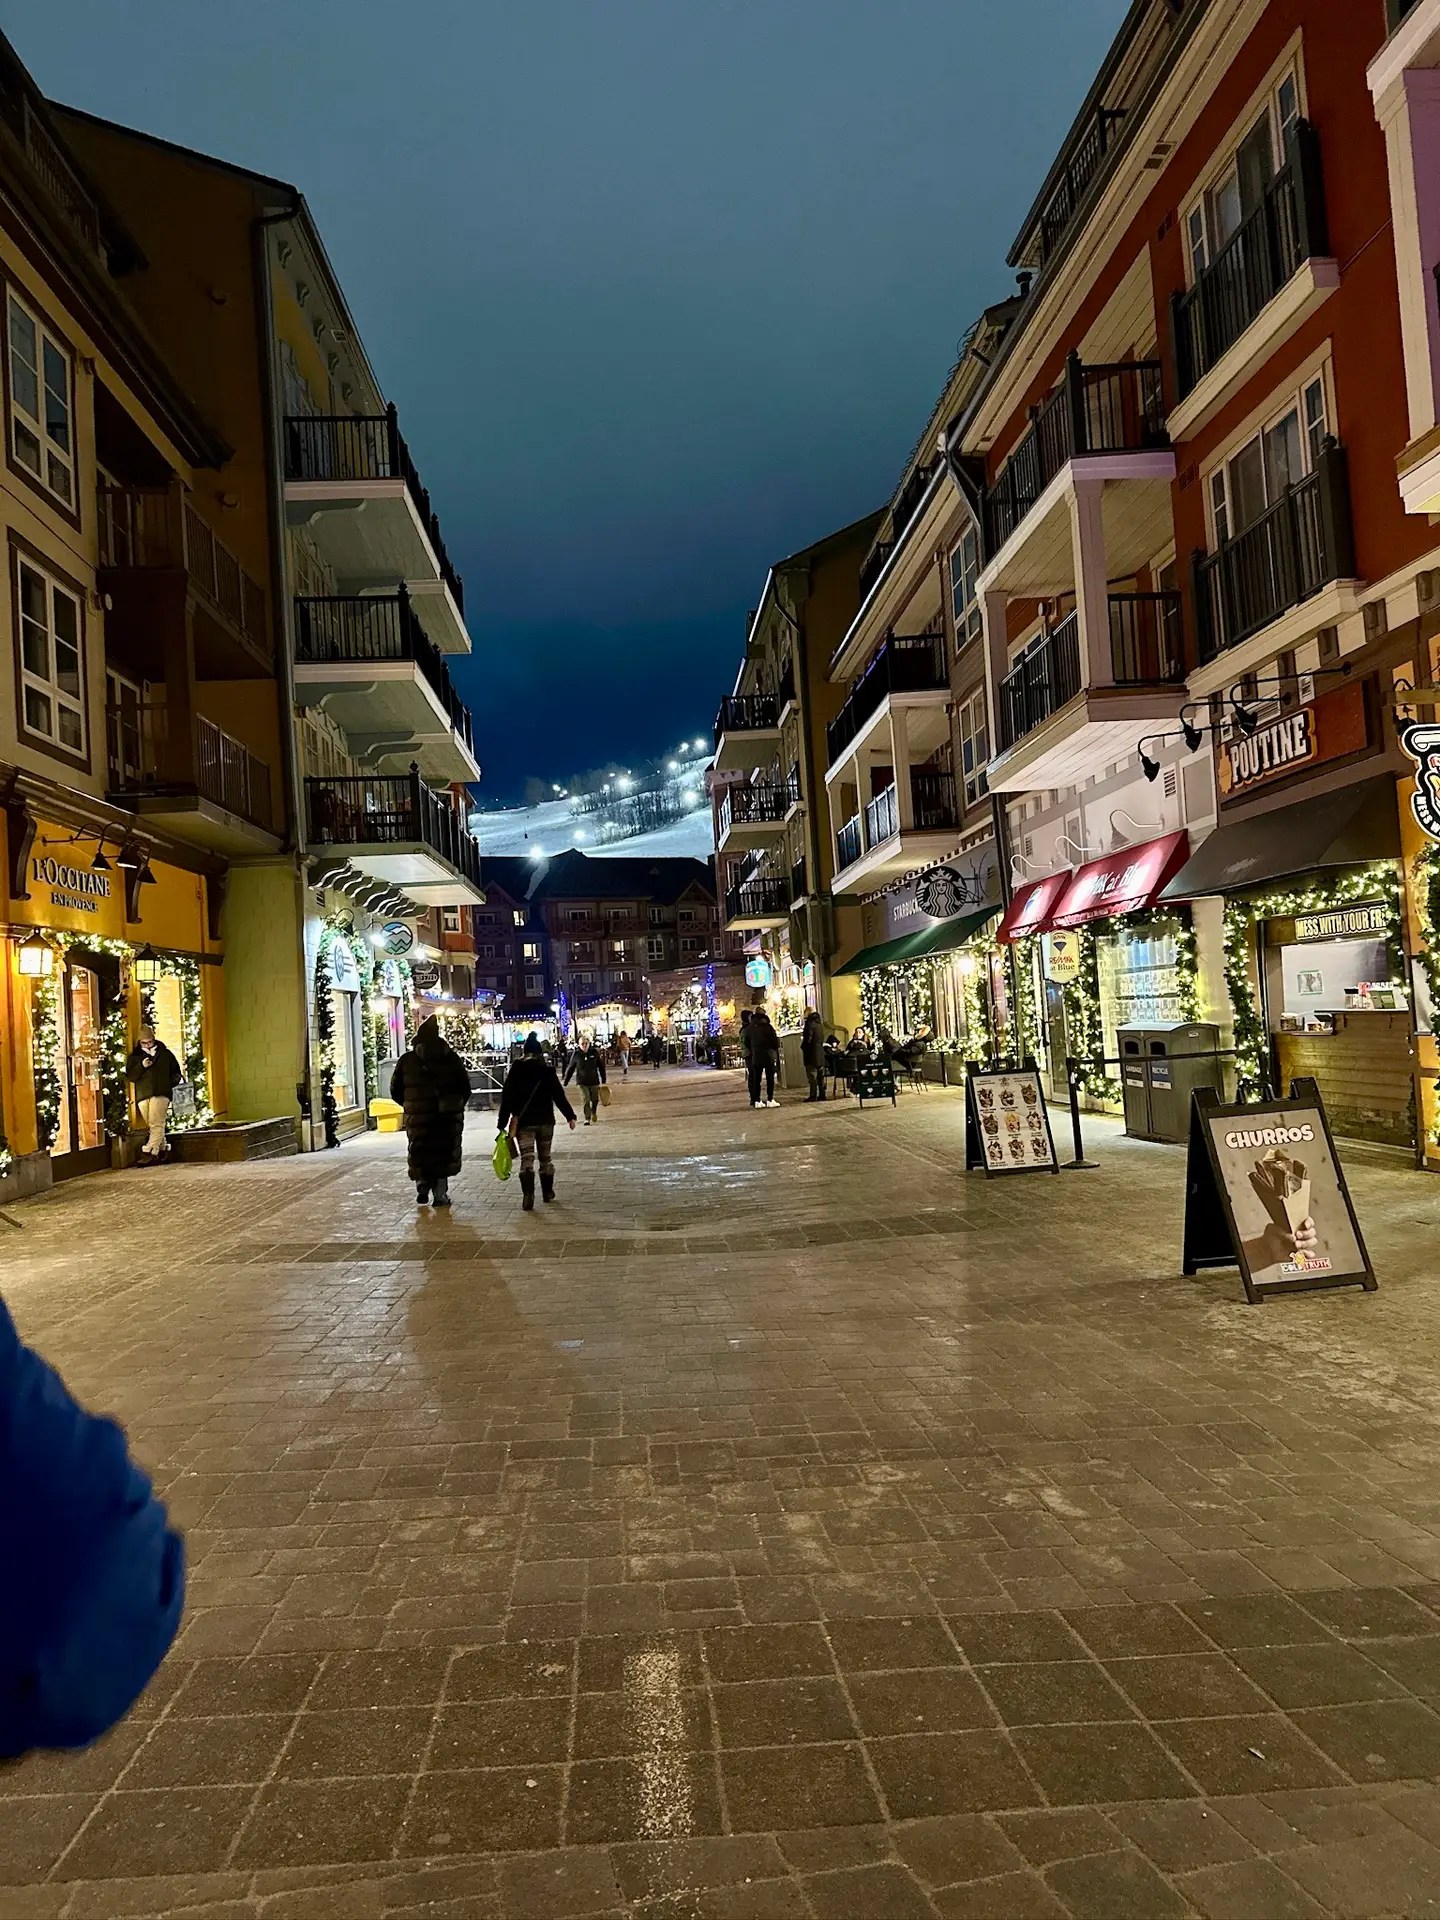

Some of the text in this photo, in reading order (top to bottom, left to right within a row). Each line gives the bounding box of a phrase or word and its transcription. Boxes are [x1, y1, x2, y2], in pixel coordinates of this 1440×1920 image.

[1230, 714, 1307, 783] POUTINE
[33, 857, 111, 898] L'OCCITANE
[1296, 918, 1319, 937] MESS
[1319, 914, 1343, 935] WITH
[1343, 910, 1369, 932] YOUR
[1057, 963, 1075, 971] Blue
[1224, 1124, 1315, 1149] CHURROS
[1304, 1259, 1329, 1270] TRUTH
